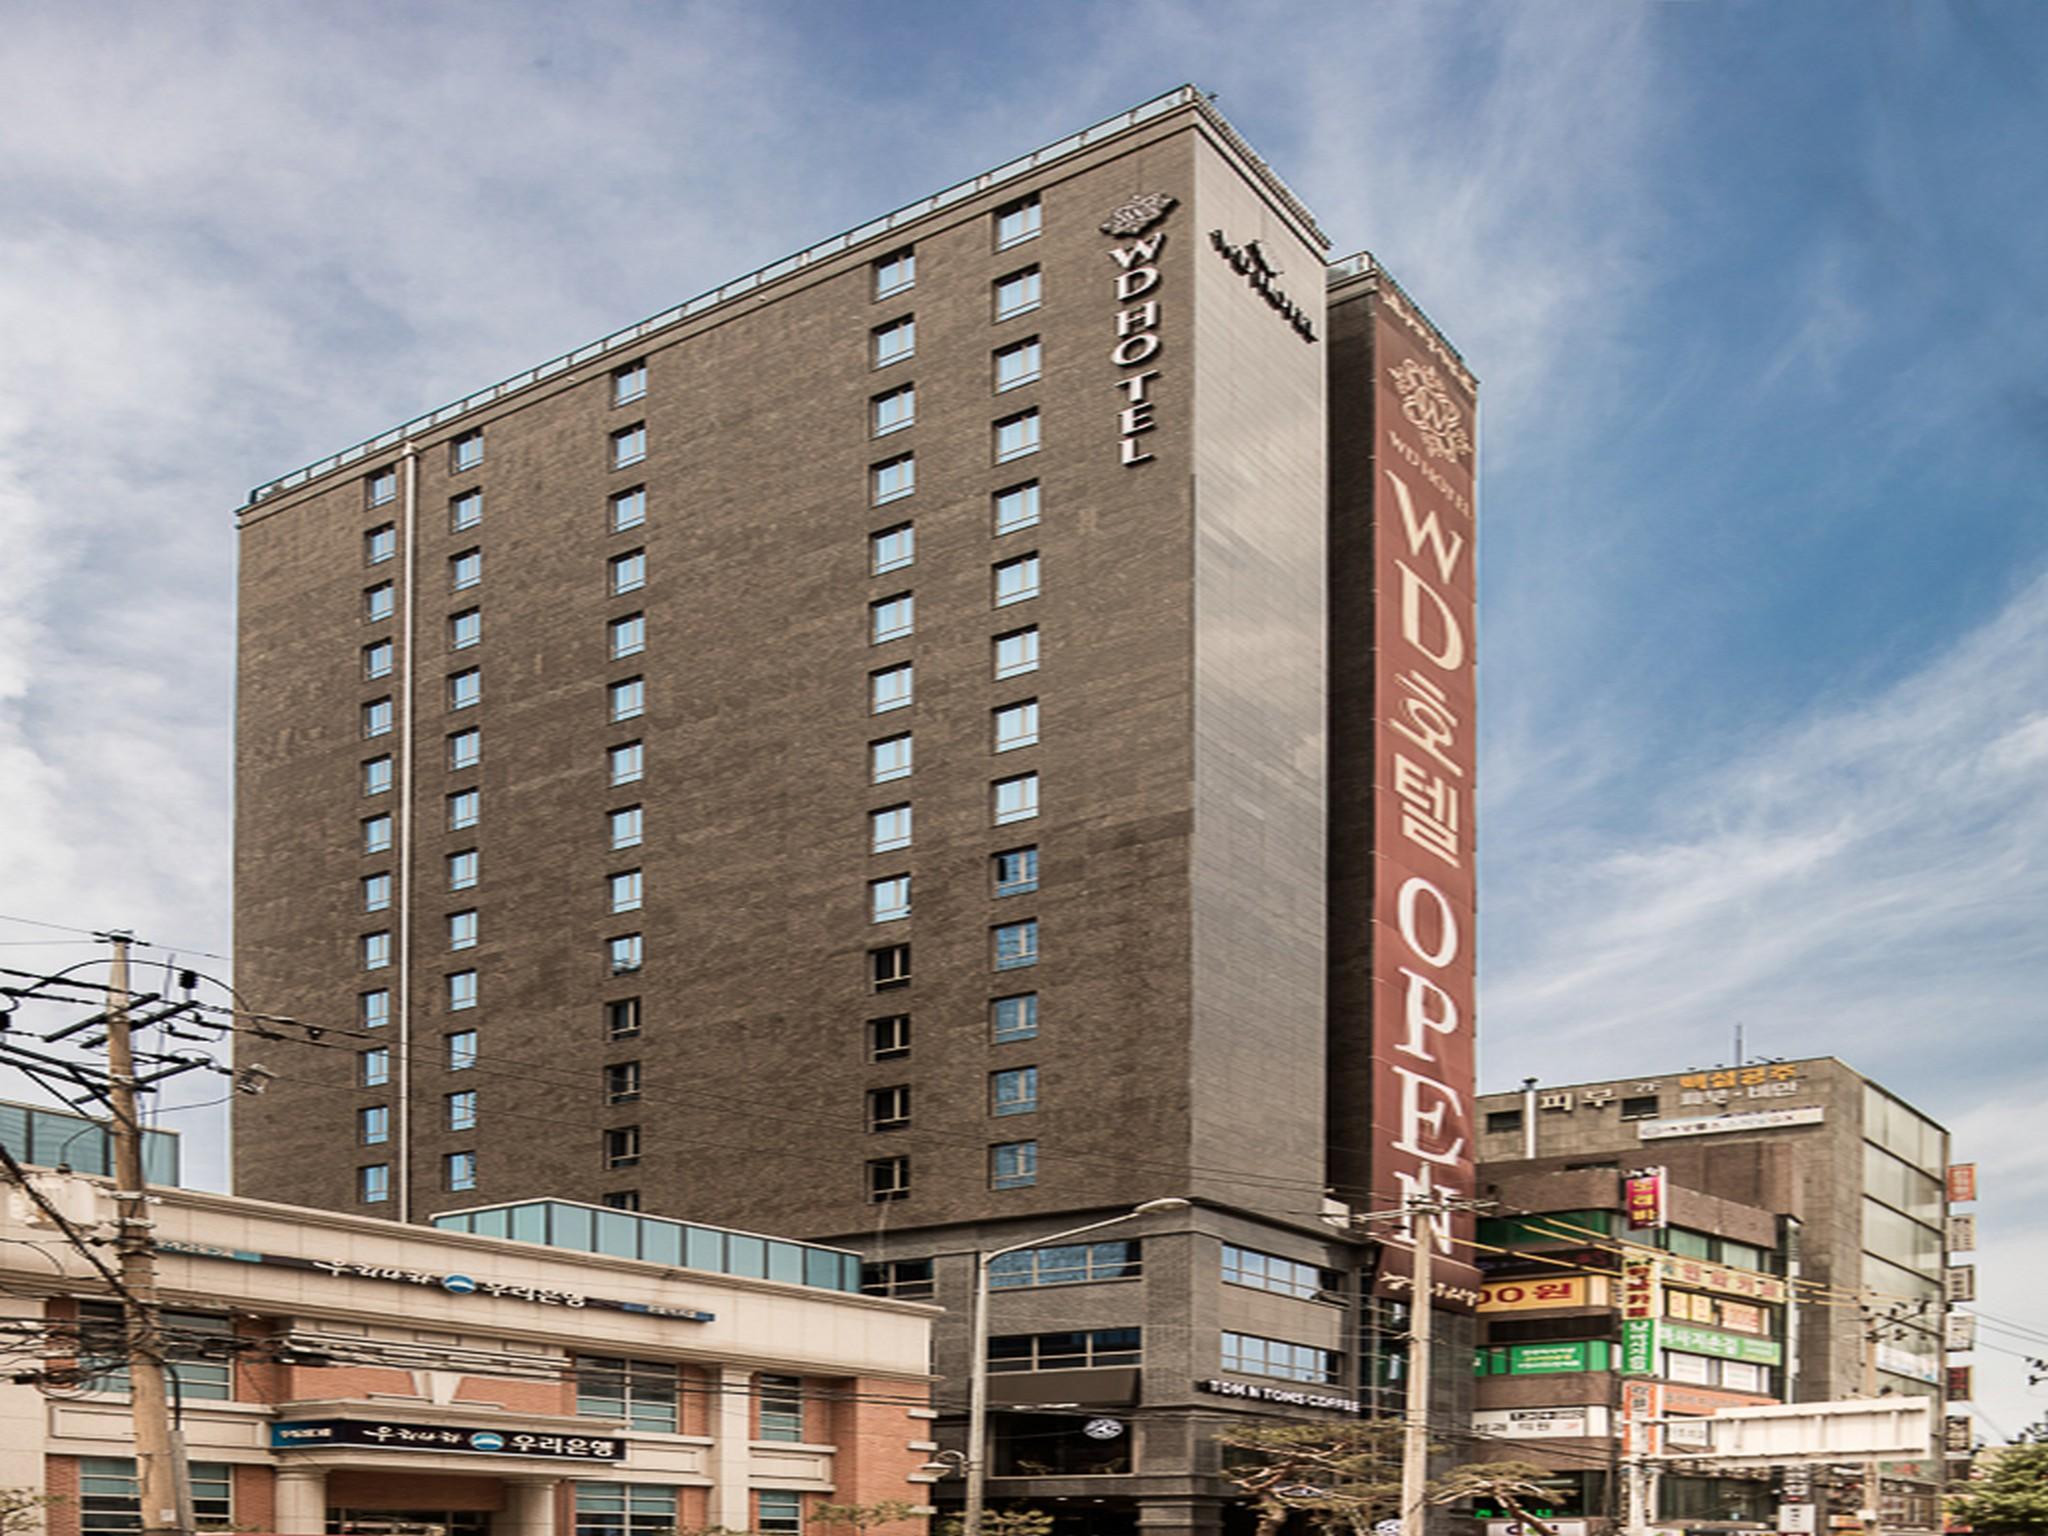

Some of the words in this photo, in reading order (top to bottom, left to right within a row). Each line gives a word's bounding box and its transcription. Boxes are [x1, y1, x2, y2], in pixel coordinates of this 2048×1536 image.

[1391, 876, 1465, 1256] OPEN
[484, 1280, 586, 1308] 우리은행
[511, 1434, 616, 1457] 우리은행
